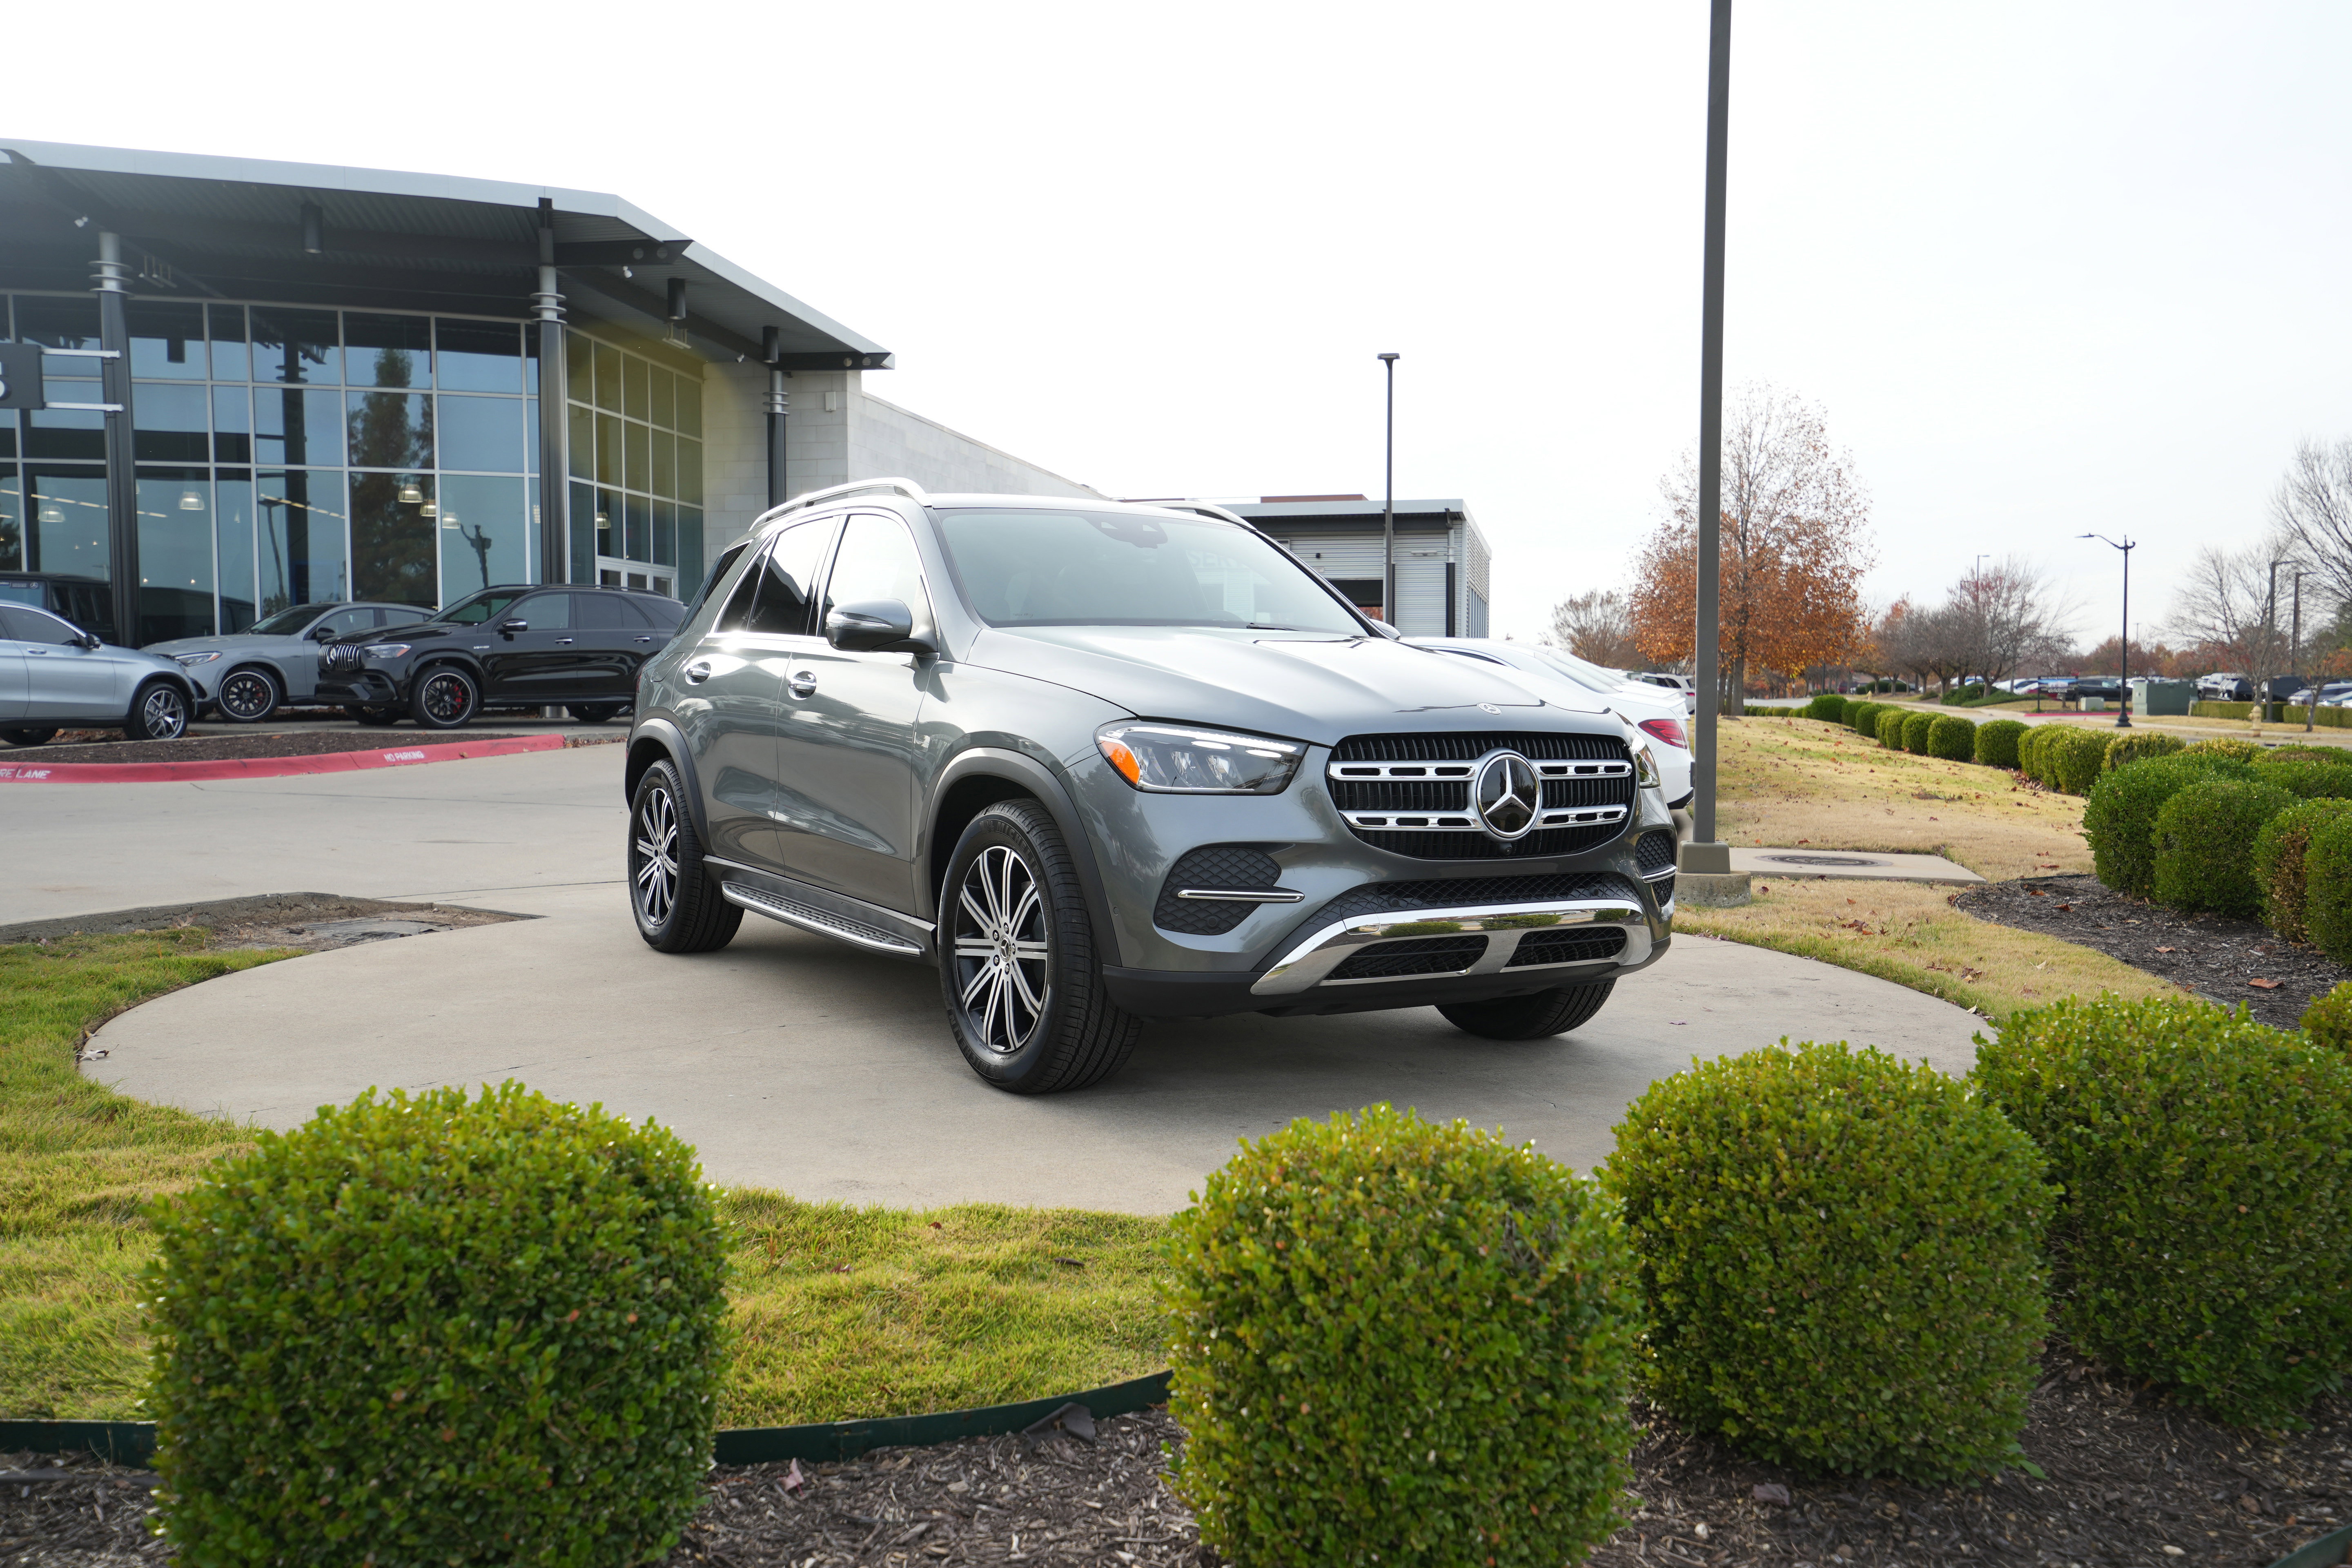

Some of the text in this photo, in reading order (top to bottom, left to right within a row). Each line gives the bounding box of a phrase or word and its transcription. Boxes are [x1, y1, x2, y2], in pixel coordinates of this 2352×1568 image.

[15, 769, 51, 779] LANE
[383, 751, 425, 762] NO PARKING
[996, 821, 1041, 878] MICHELIN
[1042, 890, 1052, 932] PRIMACY
[949, 1014, 989, 1074] MICHELIN
